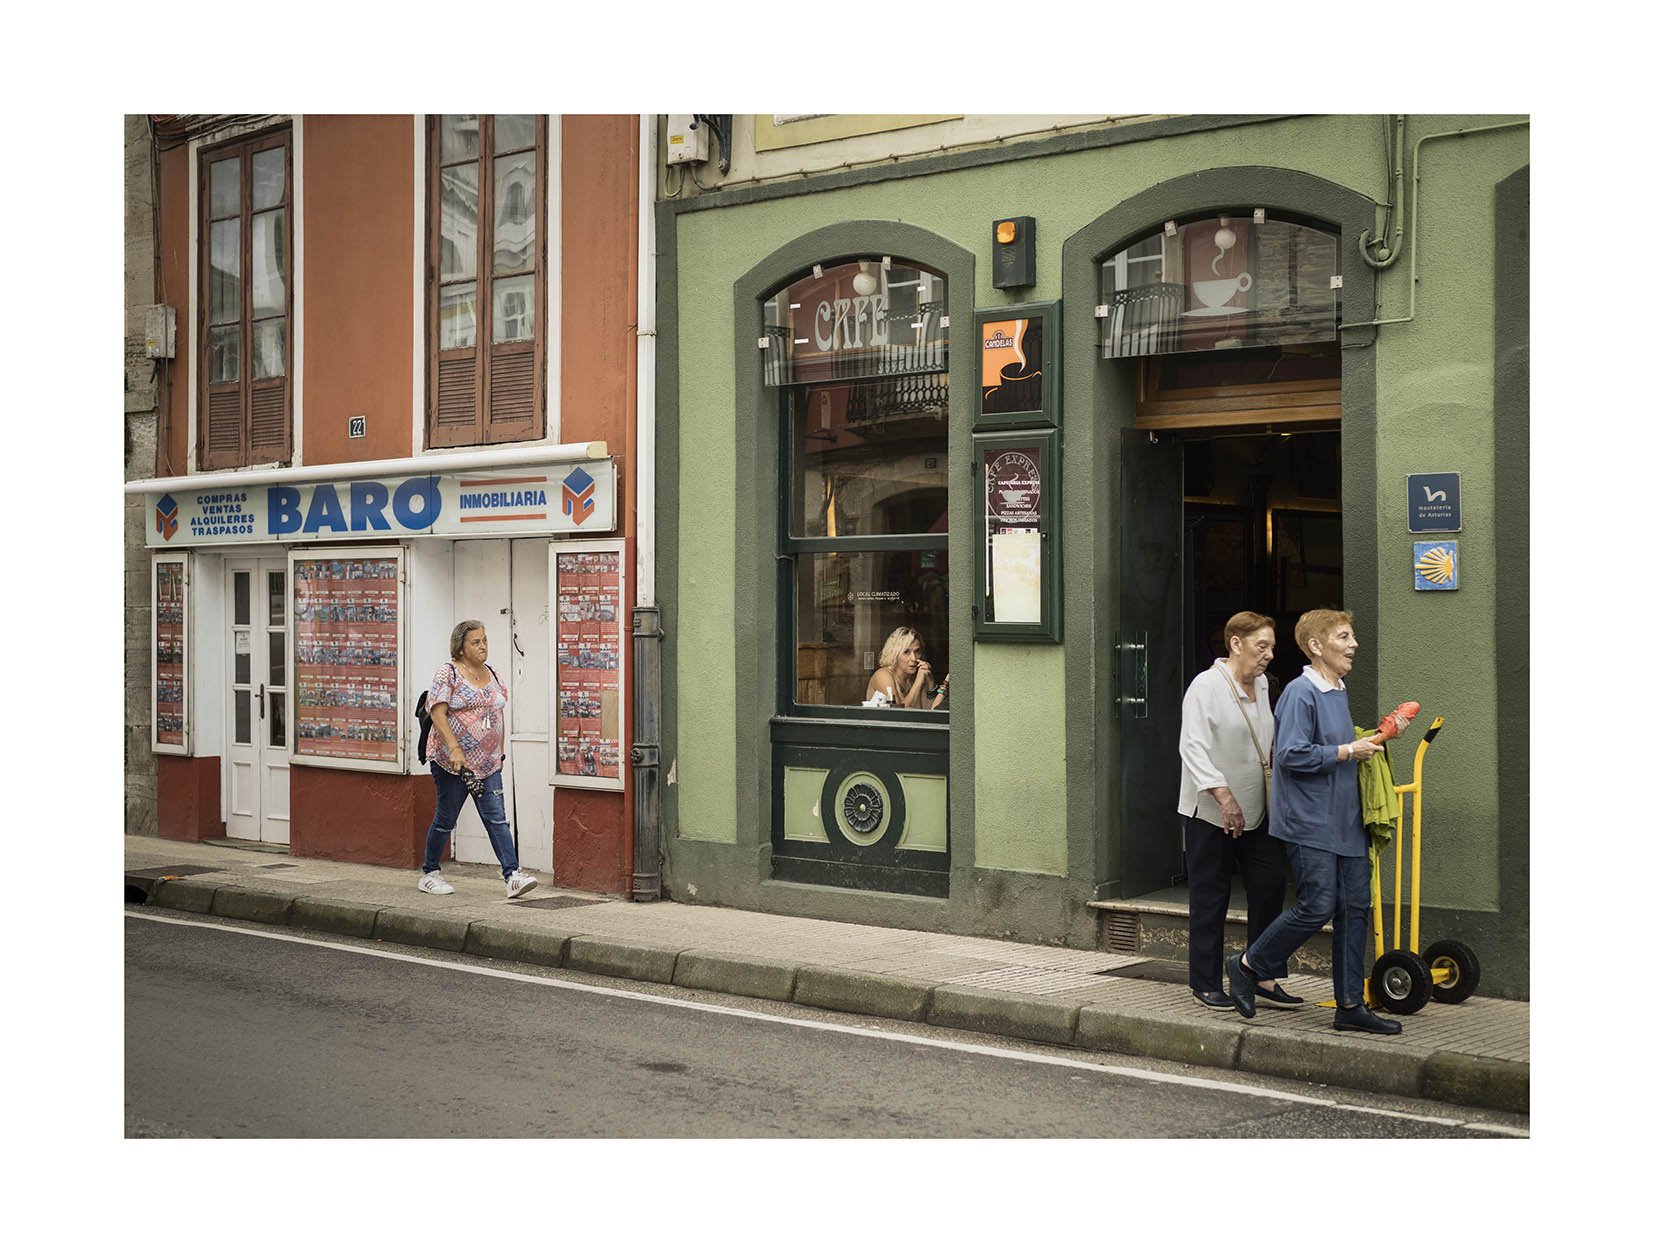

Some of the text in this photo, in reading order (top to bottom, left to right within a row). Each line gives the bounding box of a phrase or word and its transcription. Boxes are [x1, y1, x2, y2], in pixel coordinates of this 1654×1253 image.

[352, 420, 362, 434] 22
[197, 493, 247, 504] COMPRAS
[460, 490, 547, 509] INMOBILIARIA
[202, 504, 242, 514] VENTAS
[190, 514, 255, 526] ALQUILERES
[192, 525, 253, 536] TRASPASOS
